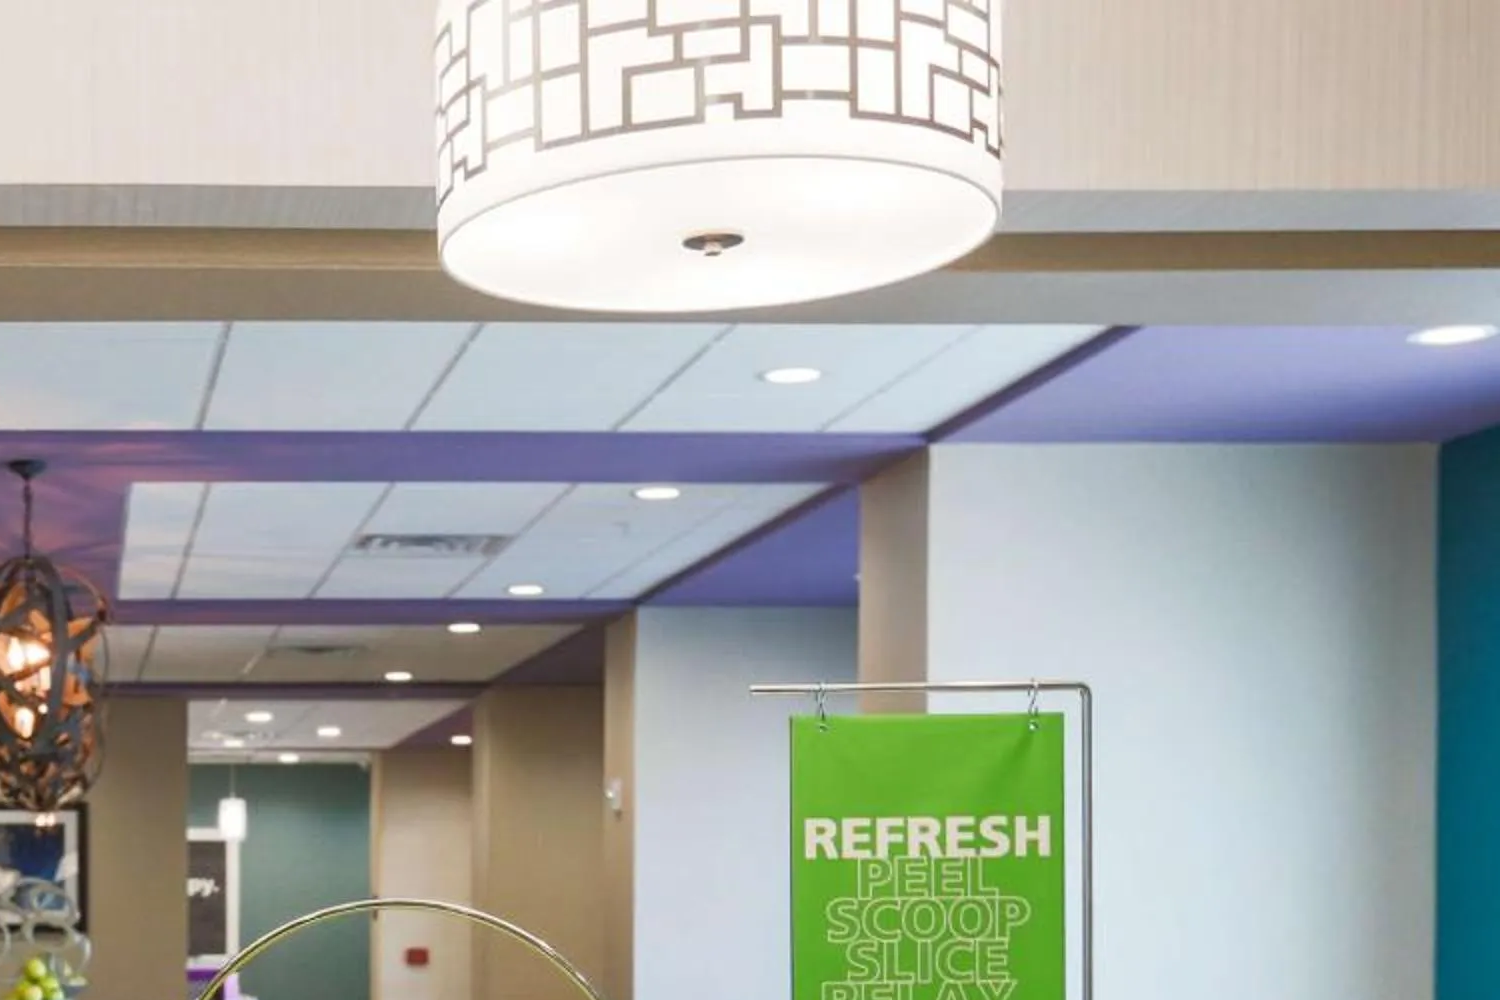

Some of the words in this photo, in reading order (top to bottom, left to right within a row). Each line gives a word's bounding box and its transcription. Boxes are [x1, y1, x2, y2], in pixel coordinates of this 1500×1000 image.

[804, 815, 1052, 860] REFRESH
[857, 856, 999, 900] PEEL
[825, 897, 1032, 942] SCOOP
[845, 938, 1010, 984] SLICE
